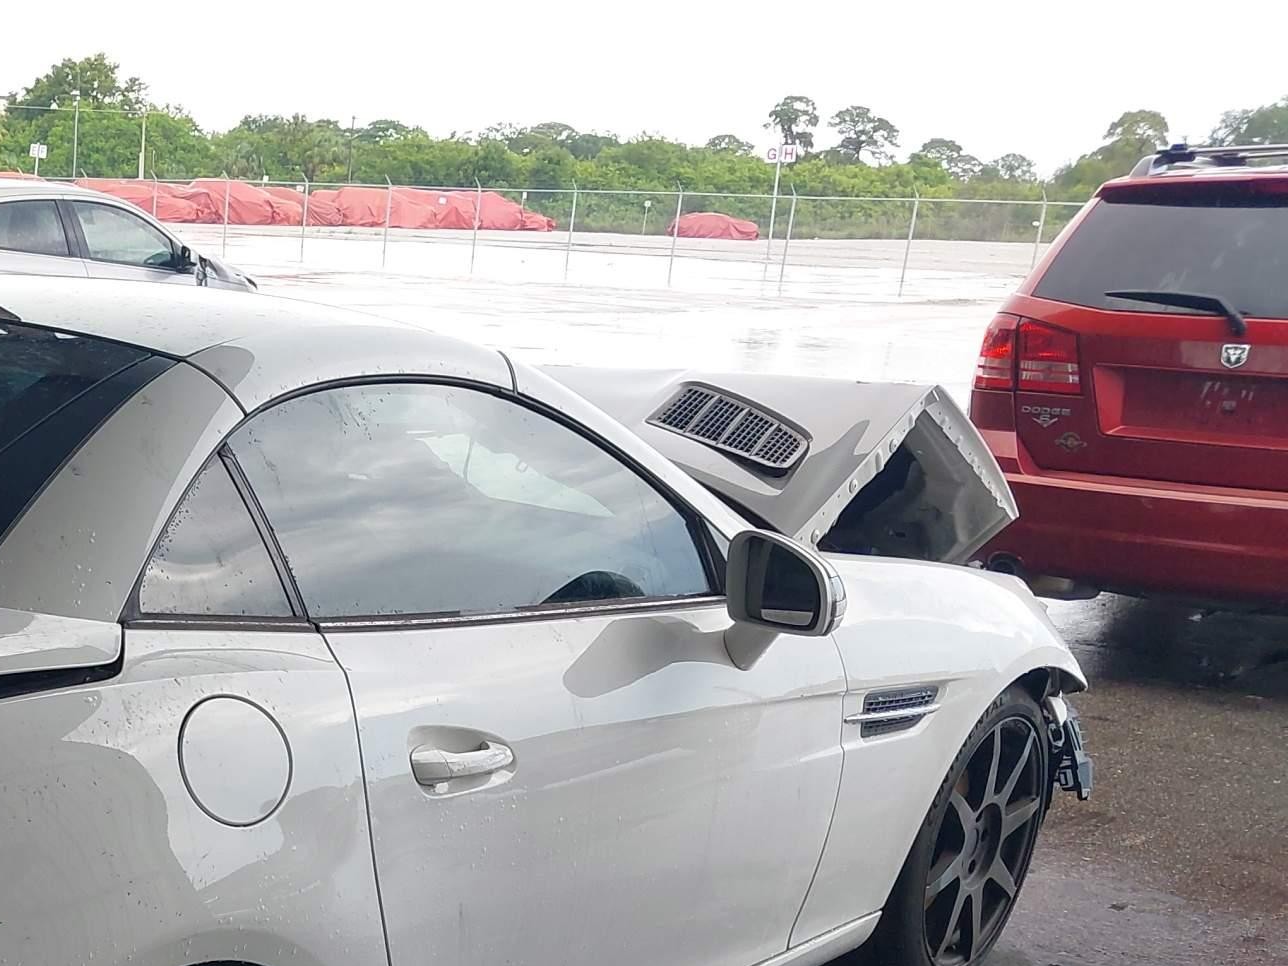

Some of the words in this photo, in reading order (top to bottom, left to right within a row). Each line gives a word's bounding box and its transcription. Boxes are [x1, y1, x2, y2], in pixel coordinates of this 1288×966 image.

[767, 147, 777, 160] G
[784, 147, 794, 160] H
[1020, 405, 1072, 416] DODGE
